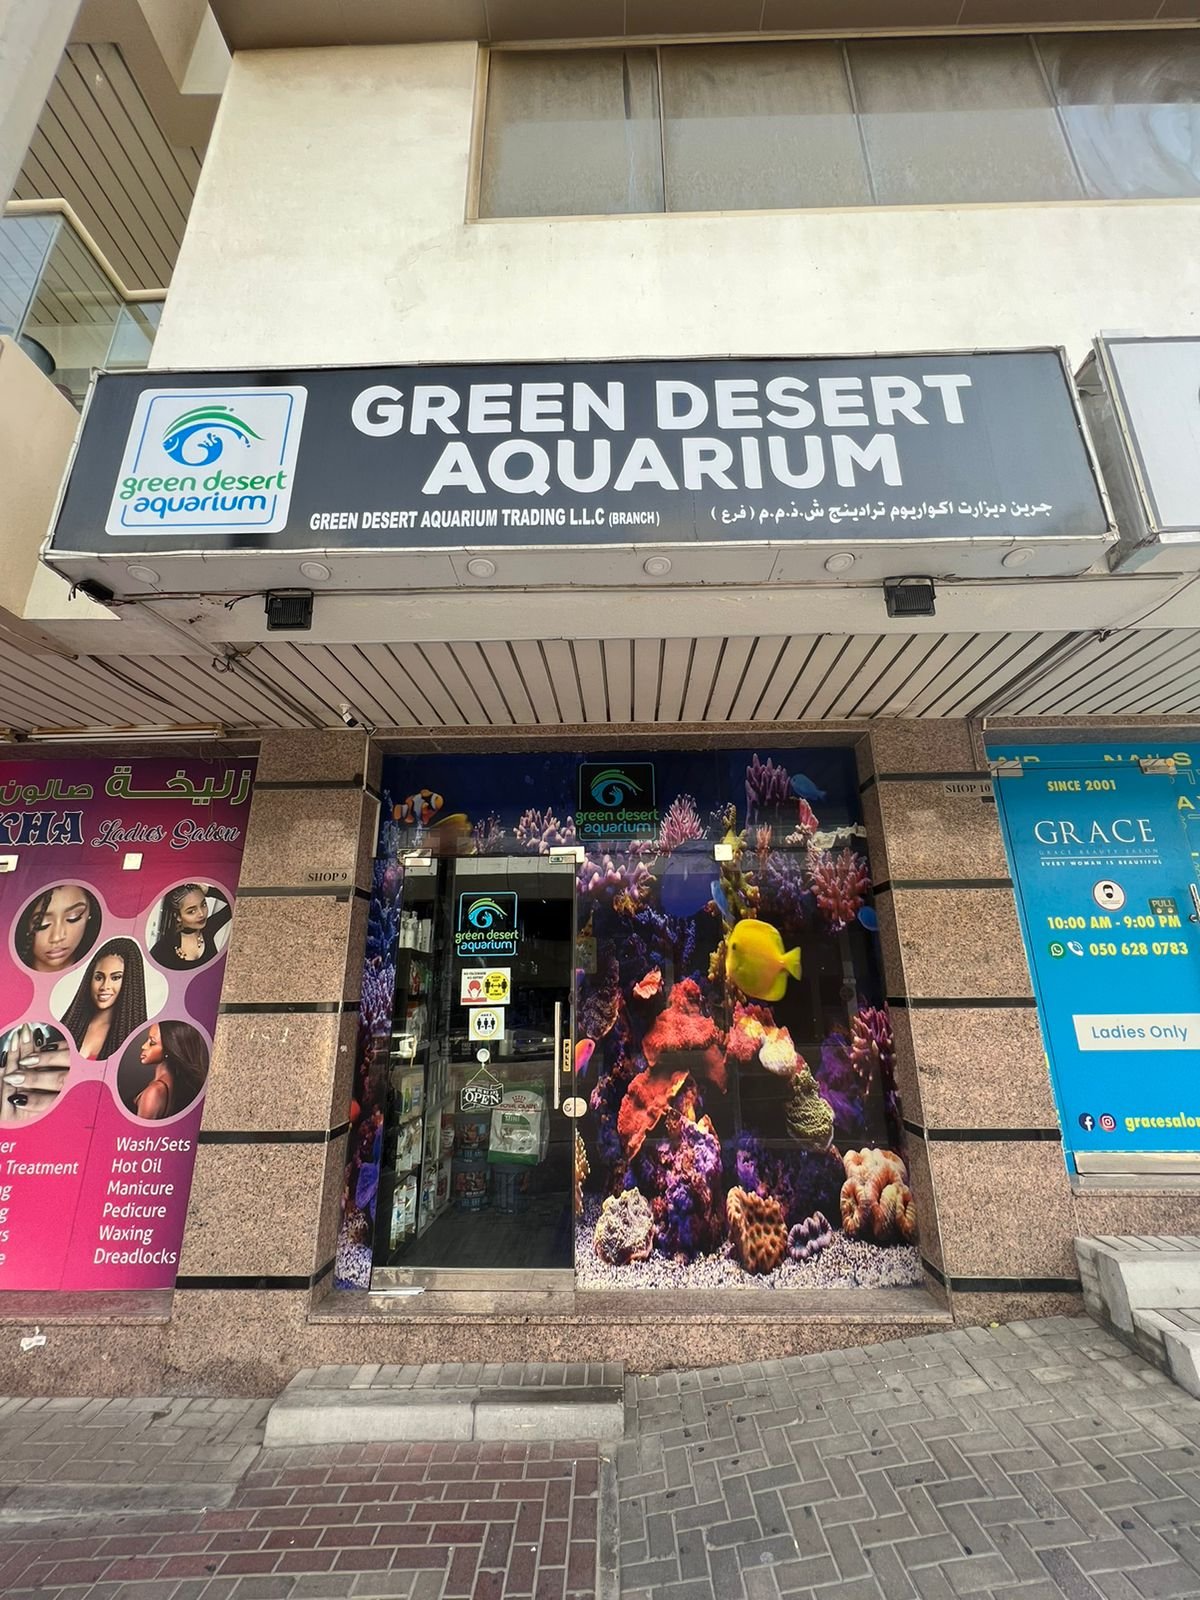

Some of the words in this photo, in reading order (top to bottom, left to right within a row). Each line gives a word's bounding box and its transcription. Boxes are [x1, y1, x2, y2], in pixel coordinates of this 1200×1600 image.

[351, 381, 625, 437] GREEN
[656, 373, 972, 431] DESERT
[421, 434, 903, 497] AQUARIUM
[119, 475, 196, 500] green
[202, 469, 288, 492] desert
[133, 492, 267, 519] aquarium
[828, 502, 886, 524] ترادينج
[890, 501, 954, 522] اكواريوم
[957, 501, 1006, 518] ديزارت
[1009, 501, 1053, 518] جرين
[309, 512, 358, 531] GREEN
[361, 511, 418, 530] DESERT
[420, 509, 498, 529] AQUARIUM
[502, 508, 566, 527] TRADING
[569, 507, 605, 526] L.L.C
[608, 511, 661, 527] (BRANCH)
[105, 765, 252, 806] زليخة
[945, 784, 977, 794] SHOP
[979, 784, 991, 793] 10
[1047, 780, 1081, 792] SINCE
[1086, 779, 1117, 791] 2001
[575, 810, 614, 826] green
[616, 808, 660, 821] desert
[91, 818, 168, 851] Ladies
[170, 818, 240, 850] Salon
[584, 821, 651, 837] aquarium
[1034, 819, 1156, 845] GRACE
[308, 872, 340, 881] SHOP
[341, 872, 348, 881] 9
[1151, 899, 1175, 908] PULL
[1047, 916, 1086, 929] 10:00
[1090, 916, 1113, 929] AM
[1124, 916, 1156, 928] 9:00
[1159, 915, 1182, 928] PM
[455, 931, 485, 944] green
[486, 929, 519, 940] desert
[460, 940, 513, 952] aquarium
[1089, 943, 1117, 955] 050
[1121, 943, 1149, 955] 628
[1152, 942, 1189, 955] 0783
[1092, 1025, 1146, 1039] Ladies
[1150, 1025, 1188, 1041] Only
[464, 1091, 500, 1105] OPEN
[115, 1137, 191, 1152] Wash/Sets
[7, 1160, 79, 1175] Treatment
[111, 1158, 138, 1174] Hot
[141, 1158, 162, 1174] Oil
[107, 1180, 174, 1195] Manicure
[102, 1202, 167, 1218] Pedicure
[99, 1225, 153, 1245] Waxing
[93, 1248, 177, 1264] Dreadlocks
